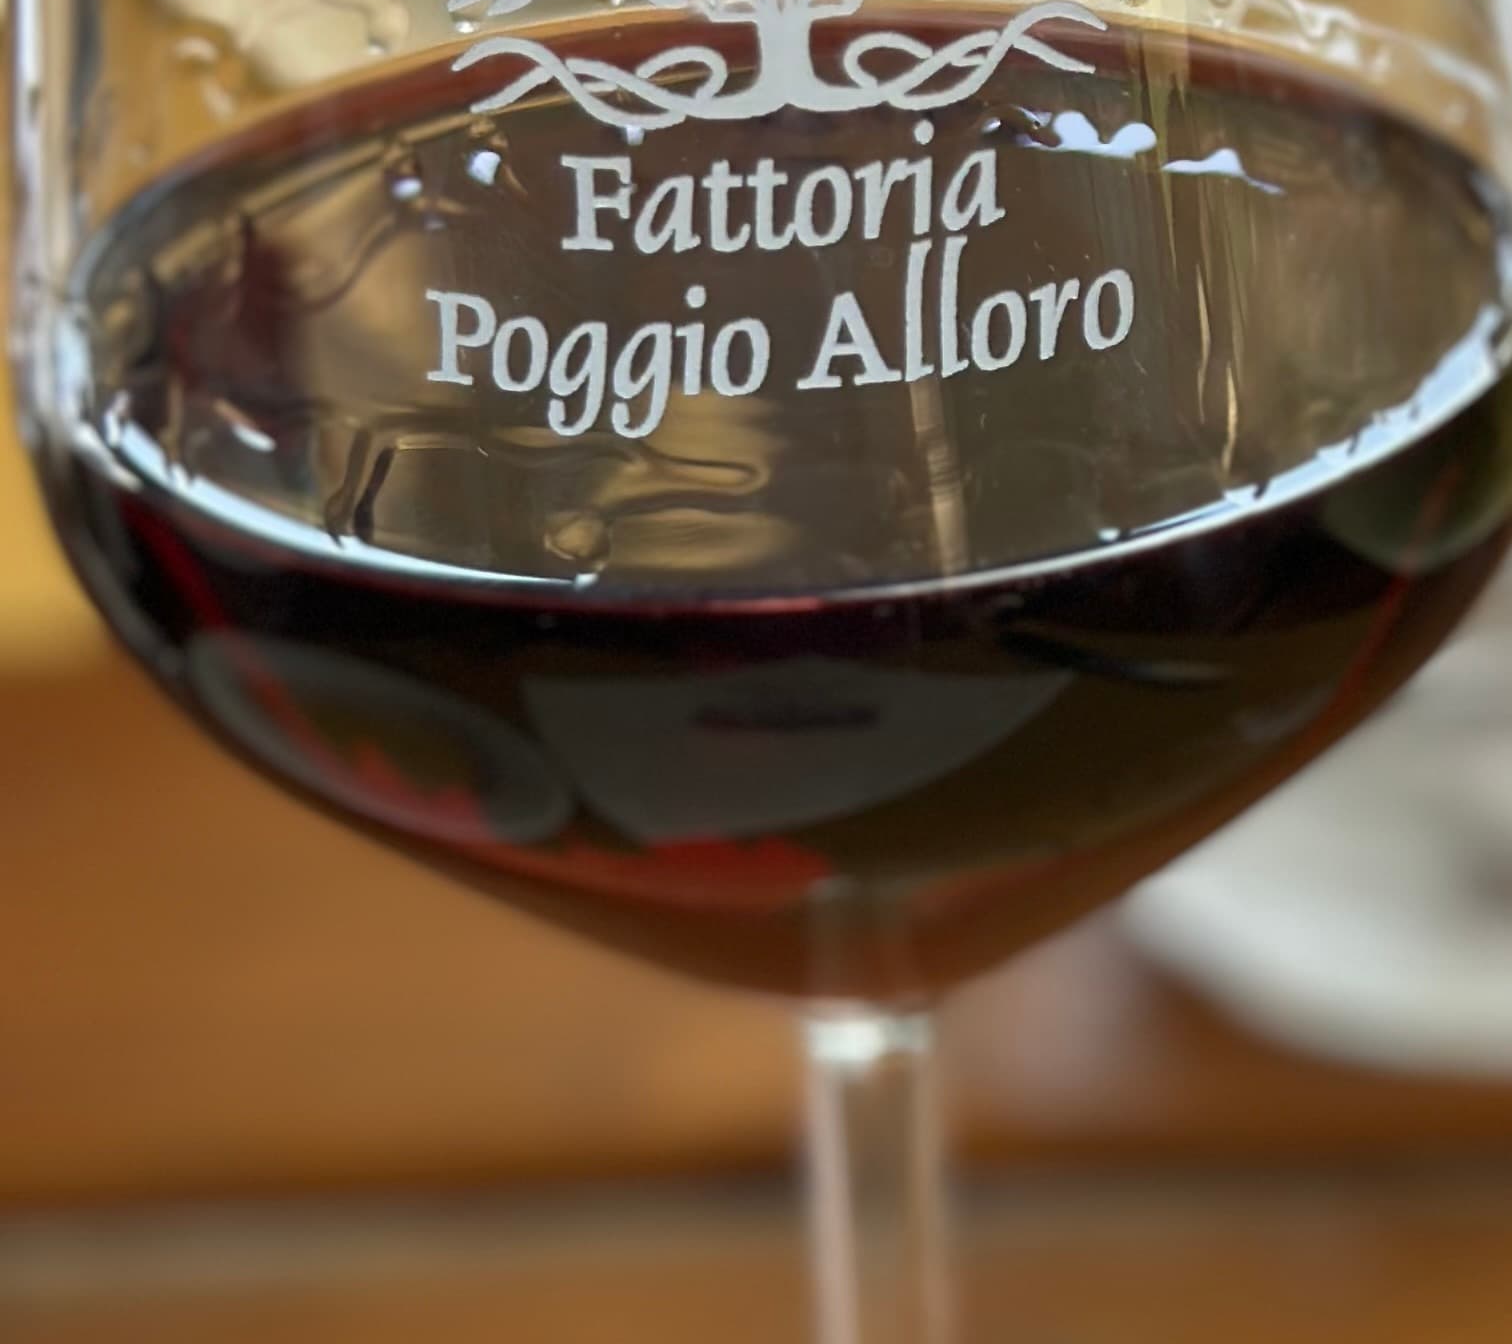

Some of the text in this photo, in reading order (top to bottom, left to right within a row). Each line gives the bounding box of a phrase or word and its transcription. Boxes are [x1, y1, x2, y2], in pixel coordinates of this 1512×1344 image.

[561, 119, 1006, 255] Fattoria
[425, 234, 1135, 439] Poggio Alloro
